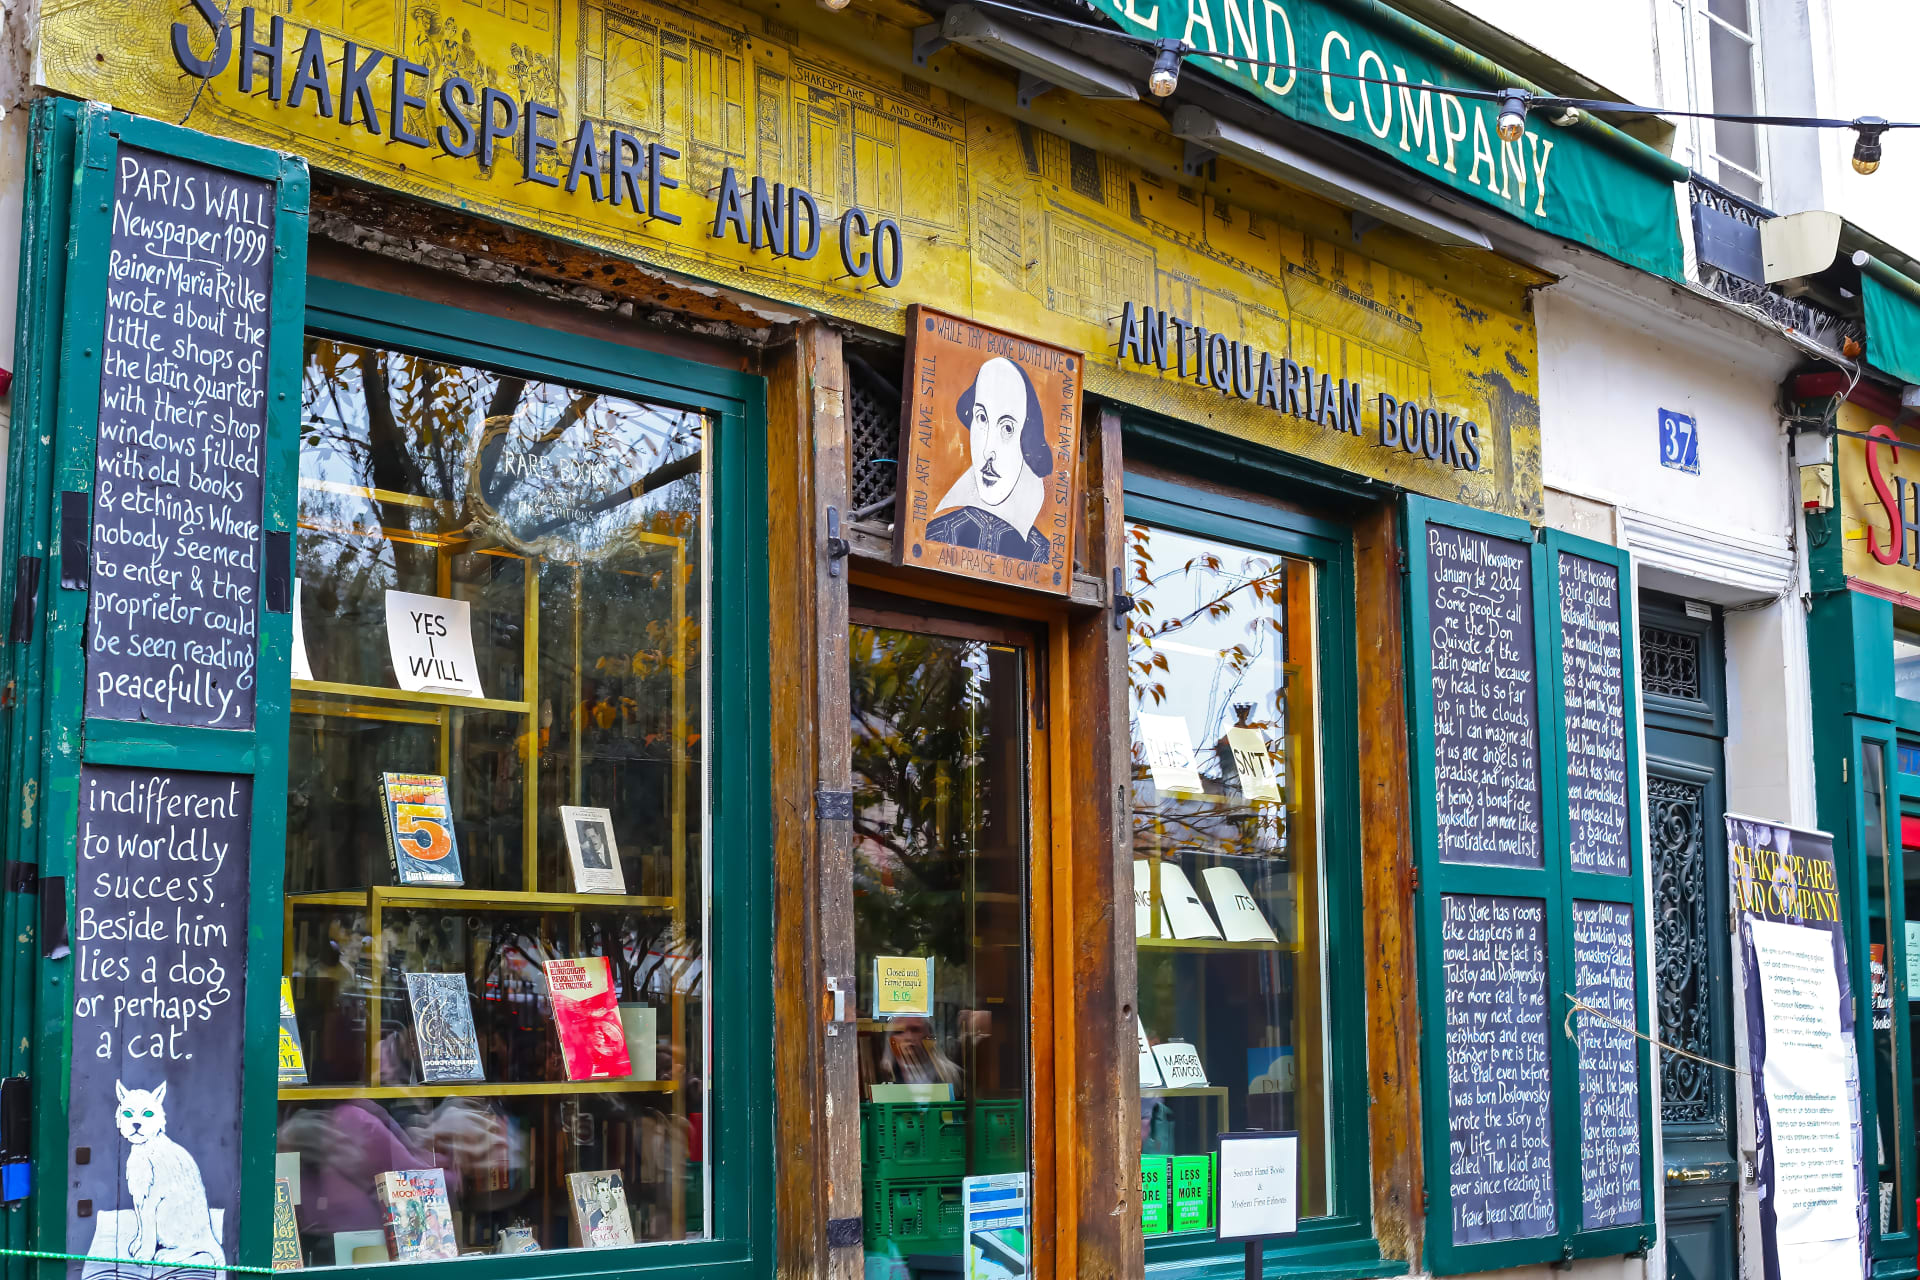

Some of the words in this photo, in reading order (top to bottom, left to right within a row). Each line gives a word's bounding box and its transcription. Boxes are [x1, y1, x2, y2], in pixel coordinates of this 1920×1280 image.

[796, 66, 866, 102] SHAKESPEARE
[890, 103, 910, 119] AND
[913, 112, 953, 134] COMPANY
[1181, 0, 1297, 96] AND
[1320, 30, 1555, 218] COMPANY
[171, 0, 682, 225] SHAKESPEARE
[712, 167, 822, 261] AND
[839, 208, 904, 289] CO
[121, 157, 195, 211] PARIS
[205, 182, 269, 229] WALL
[112, 199, 221, 262] Newspaper
[224, 224, 267, 266] 1999
[108, 250, 166, 285] Rainer
[165, 261, 214, 297] Maria
[215, 272, 266, 314] Rilke
[107, 287, 167, 319] wrote
[173, 300, 227, 337] about
[233, 313, 265, 348] the
[172, 334, 234, 376] shops
[237, 350, 263, 388] of
[937, 317, 963, 345] WHILE
[967, 326, 984, 353] THY
[987, 332, 1015, 360] BOOKE
[1018, 342, 1043, 367] DOTH
[1044, 350, 1066, 374] LIVE
[104, 348, 140, 380] the
[193, 374, 264, 409] quarter
[922, 354, 937, 398] STILL
[1060, 373, 1075, 401] AND
[1117, 301, 1362, 437] ANTIQUARIAN
[1378, 391, 1482, 472] BOOKS
[104, 384, 147, 416] with
[155, 388, 208, 429] their
[211, 406, 261, 452] shop
[919, 403, 935, 449] ALIVE
[1059, 401, 1073, 425] WE
[101, 418, 195, 456] windows
[202, 434, 260, 478] filled
[1058, 426, 1073, 464] HAVE
[1664, 418, 1693, 468] 37
[98, 447, 143, 480] with
[148, 455, 181, 488] old
[189, 461, 243, 502] books
[504, 450, 550, 480] RARE
[560, 458, 608, 485] BOOK
[915, 453, 931, 487] ART
[1055, 470, 1071, 506] WITS
[98, 480, 116, 512] &
[209, 503, 260, 542] Where
[913, 489, 928, 523] THOU
[1054, 510, 1067, 528] TO
[95, 517, 169, 564] nobody
[173, 537, 257, 573] seemed
[937, 550, 959, 567] AND
[961, 550, 998, 576] PRAISE
[1001, 559, 1013, 577] TO
[1017, 563, 1040, 584] GIVE
[1052, 531, 1066, 570] READ
[1428, 529, 1457, 560] Paris
[1458, 535, 1479, 564] Wall
[1480, 540, 1524, 580] Newspaper
[95, 552, 117, 577] to
[123, 553, 182, 591] enter
[190, 565, 204, 598] &
[212, 570, 253, 604] the
[1434, 558, 1473, 597] January
[1474, 567, 1486, 589] 1st
[1490, 571, 1522, 601] 2004
[94, 590, 202, 631] proprietor
[204, 605, 256, 638] could
[410, 611, 447, 637] YES
[1435, 587, 1467, 613] Some
[1470, 601, 1503, 624] people
[1506, 603, 1522, 624] call
[428, 636, 435, 659] I
[1433, 626, 1482, 655] Quixote
[1485, 638, 1496, 662] of
[1499, 641, 1521, 662] the
[1445, 616, 1459, 630] me
[1465, 615, 1486, 636] the
[1489, 618, 1513, 641] Don
[94, 620, 120, 655] be
[127, 633, 177, 661] seen
[184, 637, 255, 690] reading
[409, 655, 464, 683] WILL
[97, 663, 242, 725] peacefully,
[1437, 700, 1450, 720] up
[1455, 698, 1466, 717] in
[1469, 697, 1488, 719] the
[1492, 703, 1529, 728] clouds
[89, 776, 240, 824] indifferent
[83, 822, 110, 860] to
[117, 824, 229, 877] worldly
[396, 804, 452, 860] 5
[1569, 842, 1596, 866] Further
[1597, 845, 1616, 867] back
[1617, 849, 1627, 869] in
[1734, 845, 1835, 891] SHAKESPEARE
[94, 872, 226, 908] success.
[1441, 896, 1466, 922] This
[1468, 897, 1491, 923] store
[1492, 899, 1510, 921] has
[1512, 905, 1542, 923] rooms
[1736, 880, 1766, 913] AND
[1768, 884, 1840, 922] COMPANY
[77, 906, 168, 941] Beside
[176, 906, 228, 948] him
[1441, 920, 1466, 941] like
[1467, 923, 1513, 948] chapters
[1515, 923, 1525, 940] in
[1528, 926, 1536, 941] a
[80, 945, 130, 982] lies
[141, 956, 157, 983] a
[169, 950, 231, 1006] dog
[75, 994, 105, 1018] or
[114, 986, 212, 1032] perhaps
[1446, 1006, 1469, 1026] than
[1473, 1011, 1488, 1029] my
[1490, 1006, 1513, 1025] next
[1516, 1007, 1544, 1024] door
[96, 1031, 112, 1060] a
[128, 1024, 193, 1060] cat.
[1583, 1100, 1592, 1118] at
[1142, 1171, 1159, 1183] ESS
[1180, 1169, 1200, 1181] LESS
[1142, 1189, 1161, 1202] ORE
[1178, 1186, 1202, 1199] MORE
